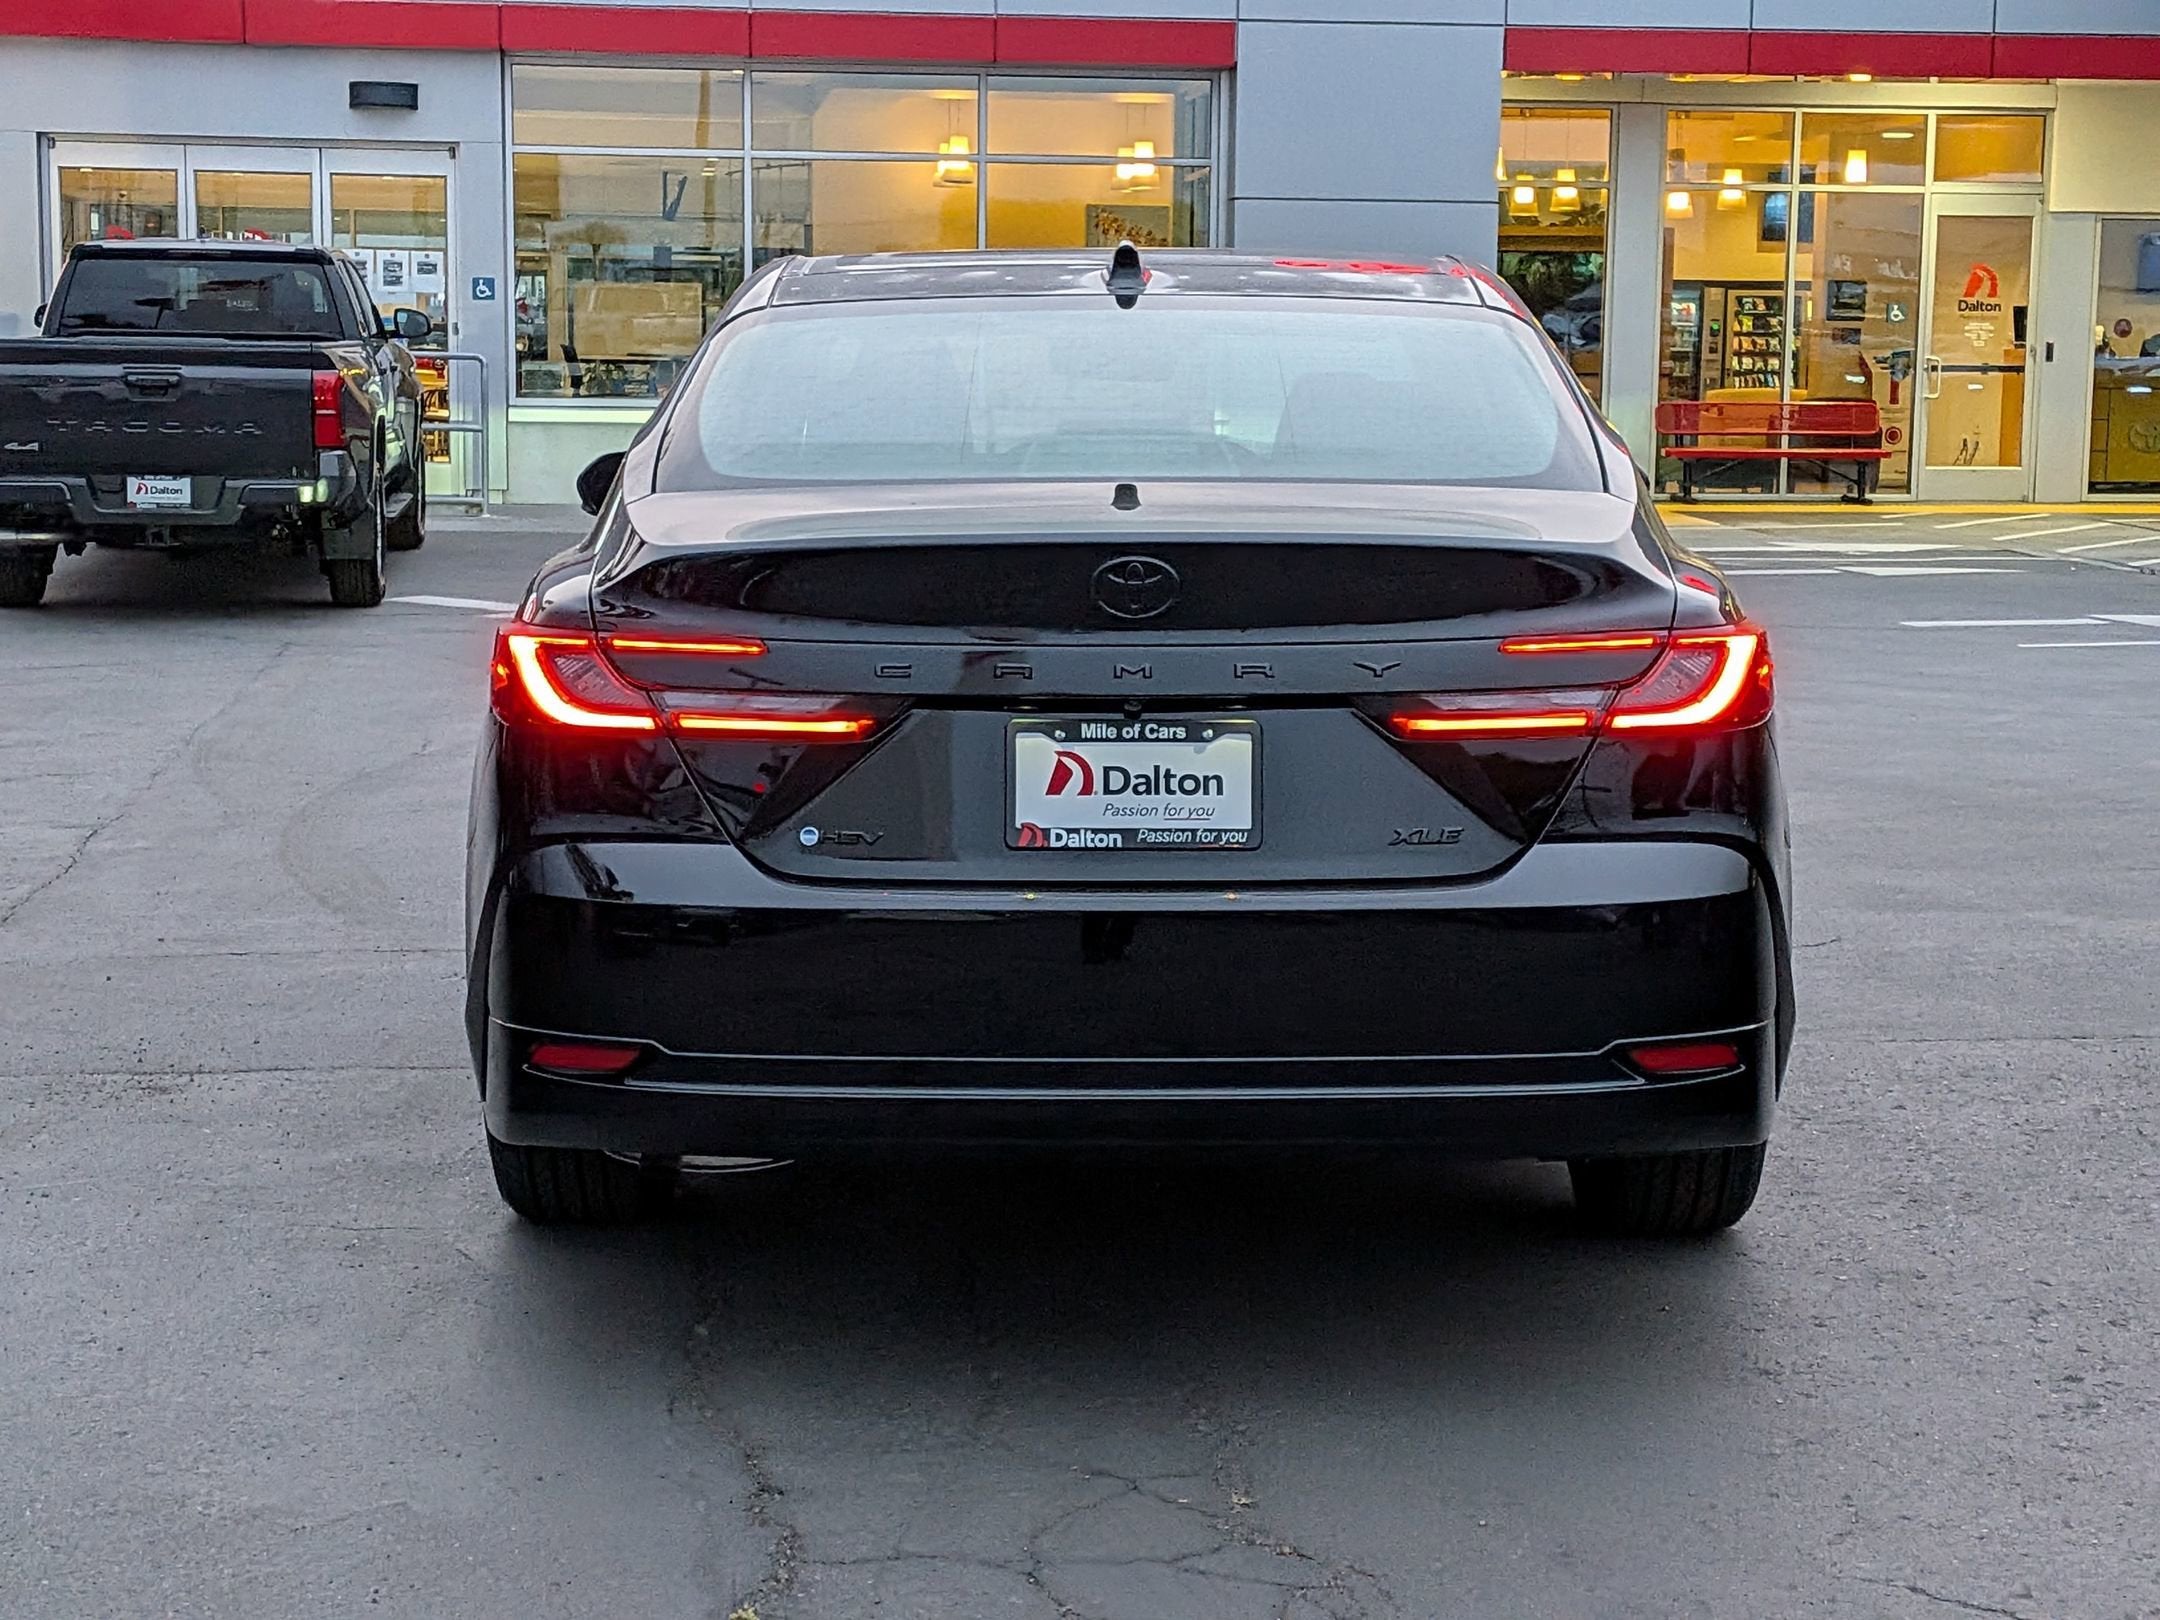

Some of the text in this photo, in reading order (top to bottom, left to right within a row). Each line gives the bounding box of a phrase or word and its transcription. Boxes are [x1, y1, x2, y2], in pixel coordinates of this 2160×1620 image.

[1958, 299, 2002, 312] Dalton
[47, 419, 263, 435] TACOMA
[150, 485, 183, 495] Dalton
[874, 661, 1402, 680] CAMRY
[1081, 723, 1187, 739] Mile of Cars
[1102, 765, 1224, 796] Dalton
[1103, 803, 1215, 819] Passion for you
[820, 830, 885, 846] HEV
[1050, 828, 1122, 848] Dalton
[1137, 828, 1248, 846] Passion for you
[1388, 827, 1465, 847] XLE
